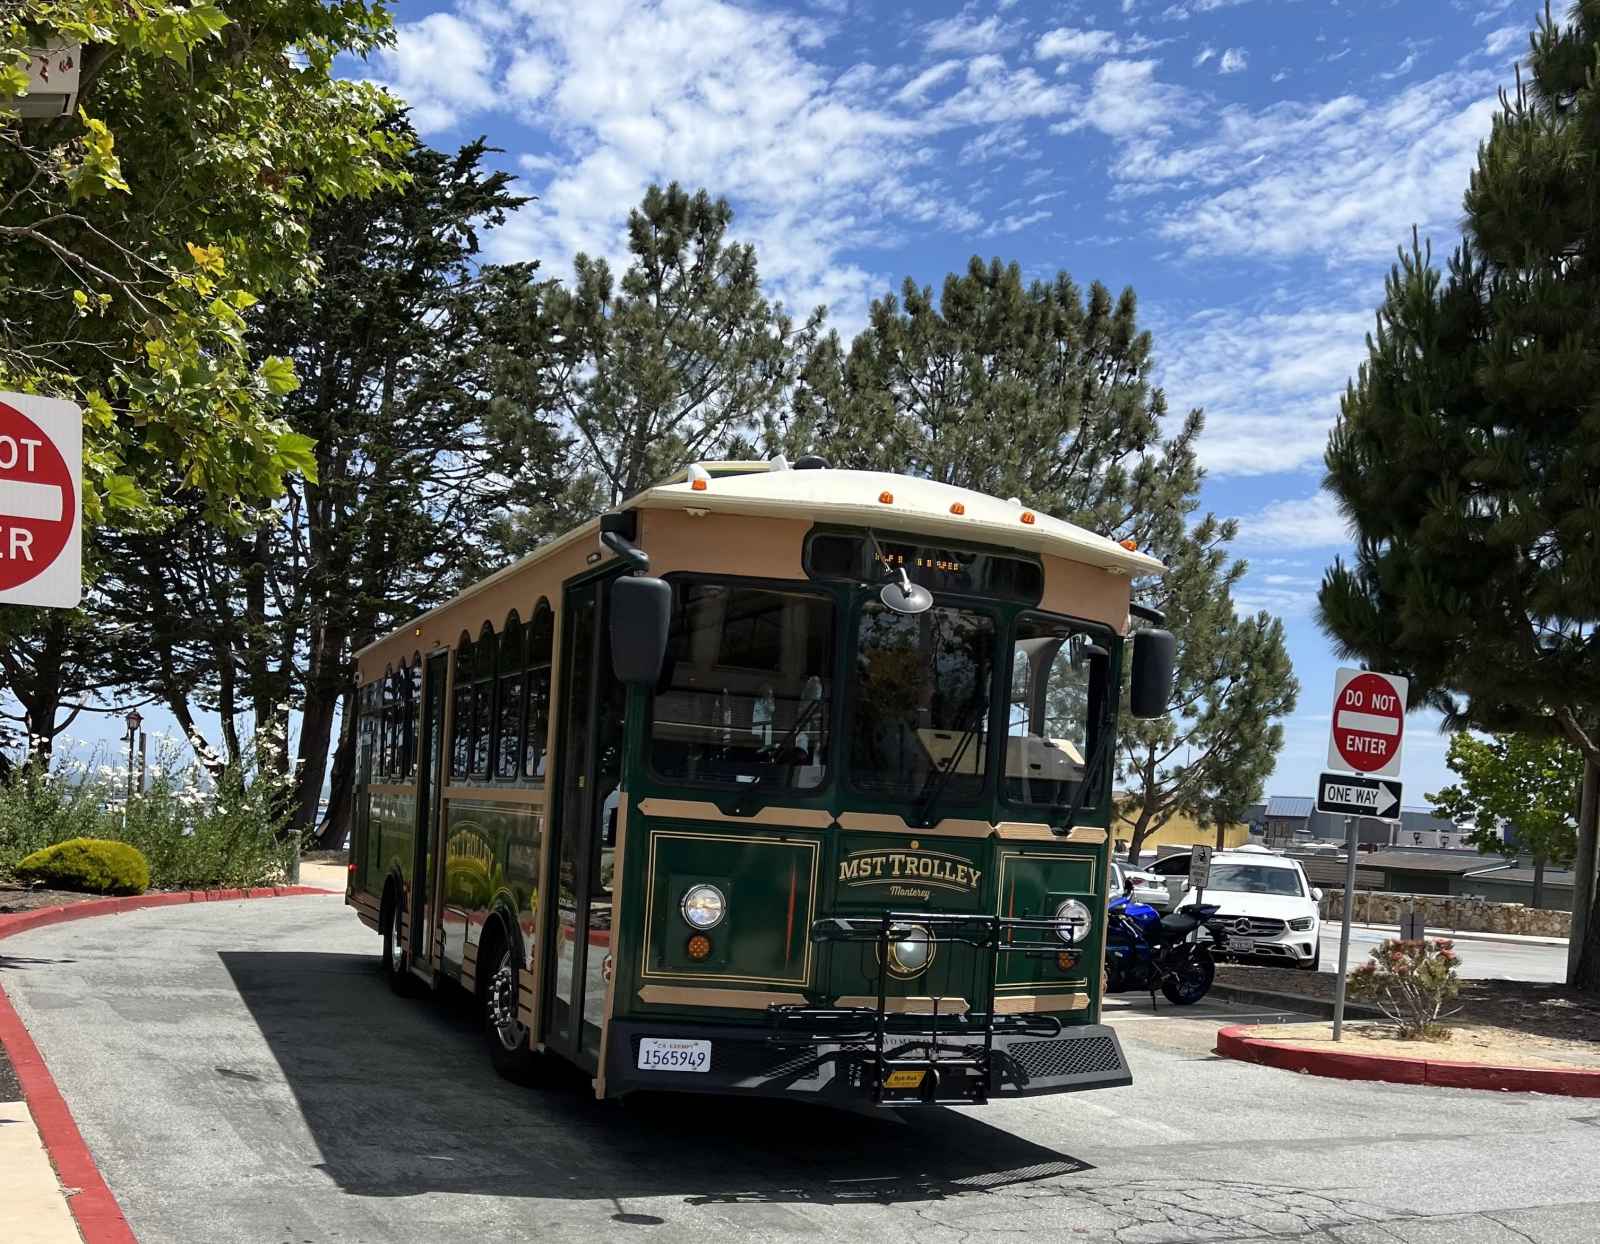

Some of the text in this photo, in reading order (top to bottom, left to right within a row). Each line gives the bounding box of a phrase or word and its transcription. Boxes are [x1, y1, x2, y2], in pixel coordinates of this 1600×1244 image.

[0, 526, 34, 561] R
[1345, 689, 1396, 711] DO NOT
[1346, 735, 1387, 756] ENTER
[1327, 785, 1379, 805] ONE WAY
[838, 854, 982, 889] MST TROLLEY
[888, 885, 930, 901] Monterey
[643, 1049, 706, 1067] 1565949
